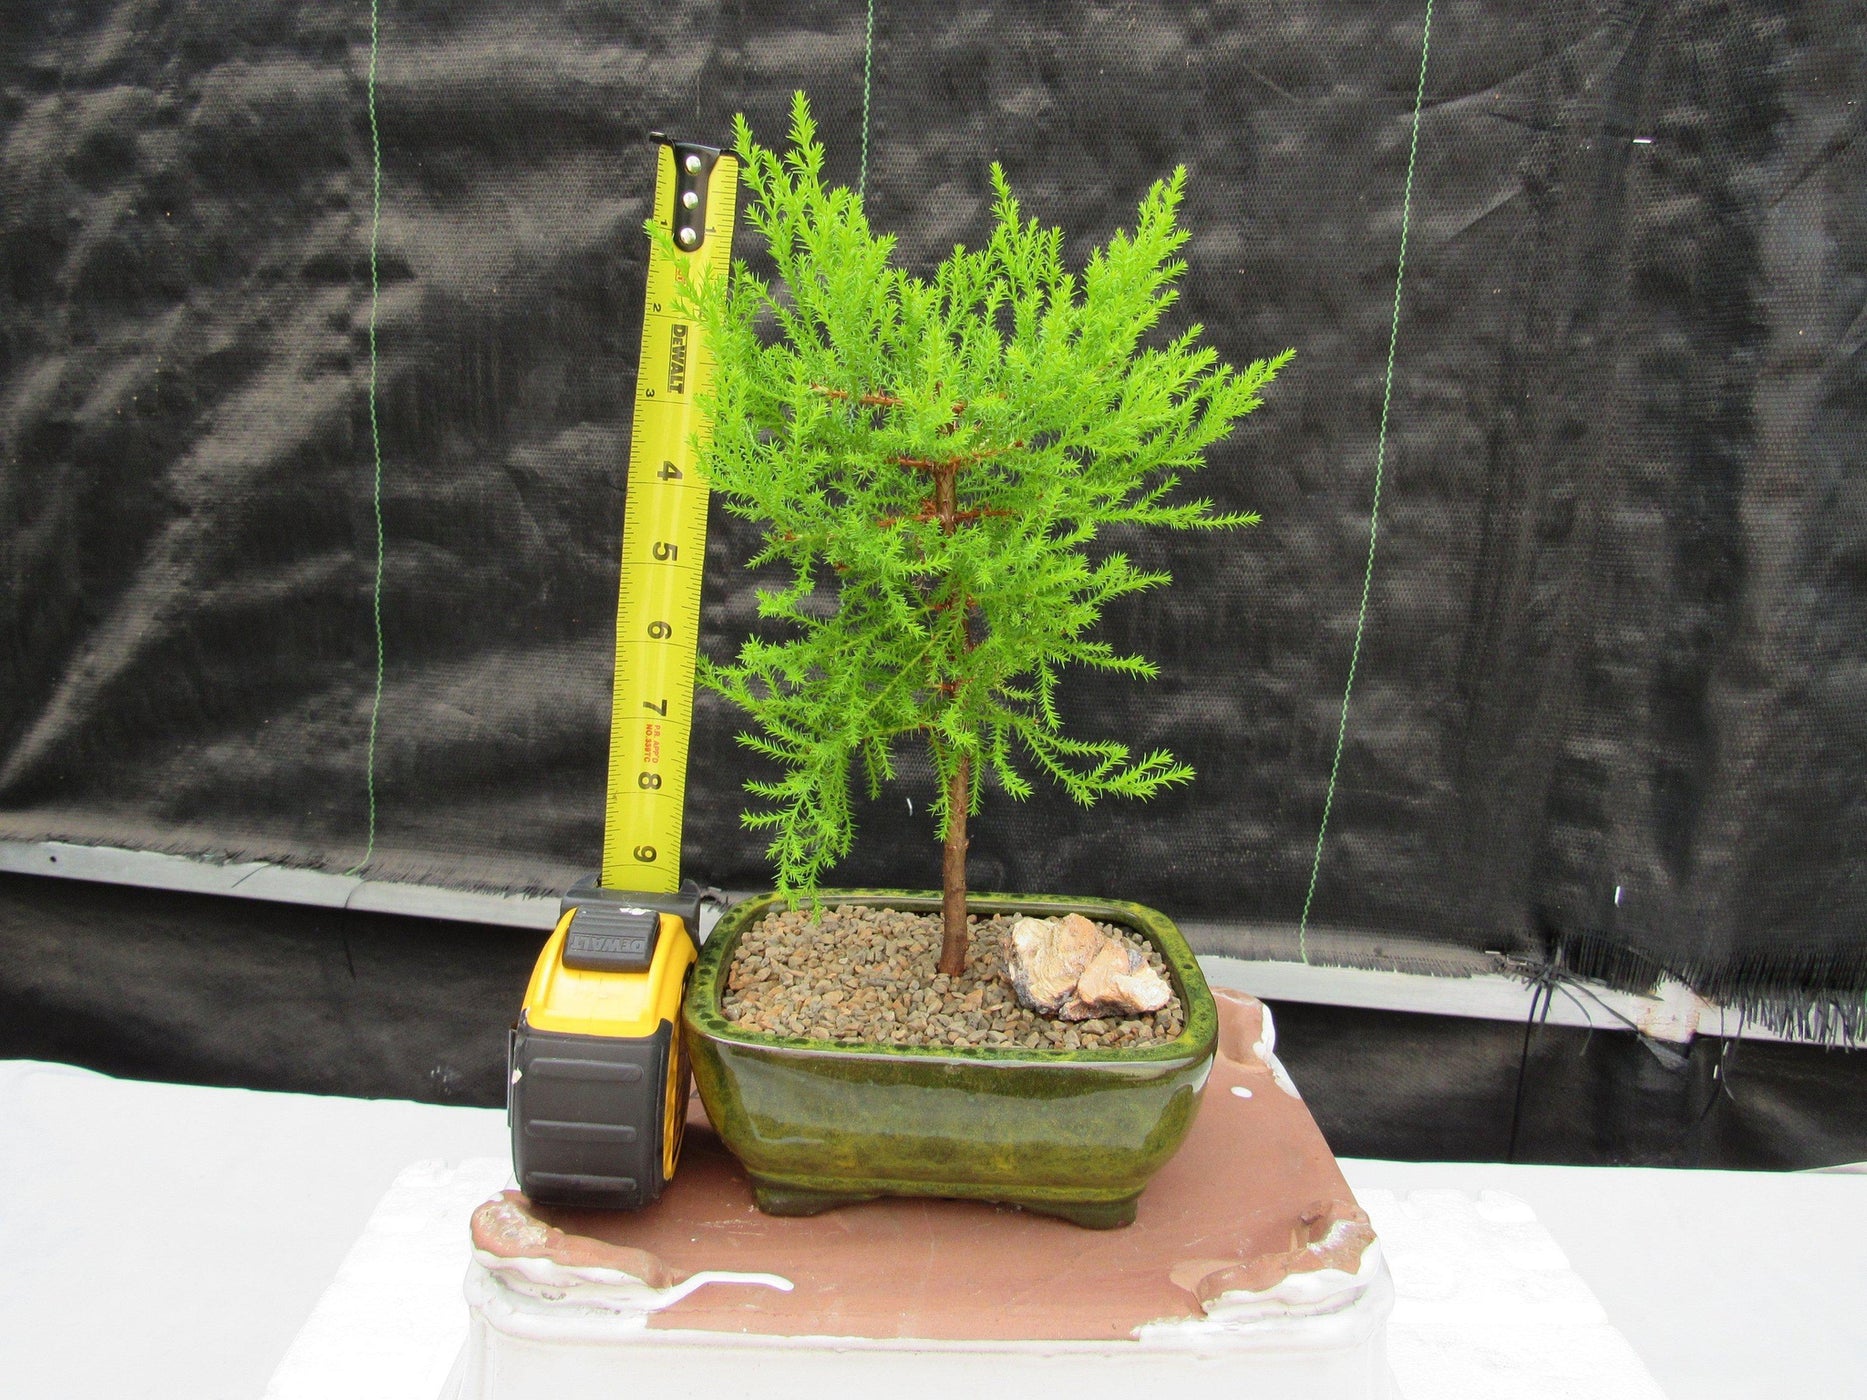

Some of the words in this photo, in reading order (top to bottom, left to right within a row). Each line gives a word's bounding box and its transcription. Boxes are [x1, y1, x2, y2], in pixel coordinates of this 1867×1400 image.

[652, 303, 662, 313] 2
[669, 324, 688, 394] DEWALT
[645, 388, 655, 398] 3
[657, 460, 683, 482] 4
[652, 541, 678, 562] 5
[647, 620, 672, 640] 6
[643, 699, 667, 717] 7
[638, 771, 662, 790] 8
[633, 845, 657, 863] 9
[570, 934, 644, 952] DEWALT
